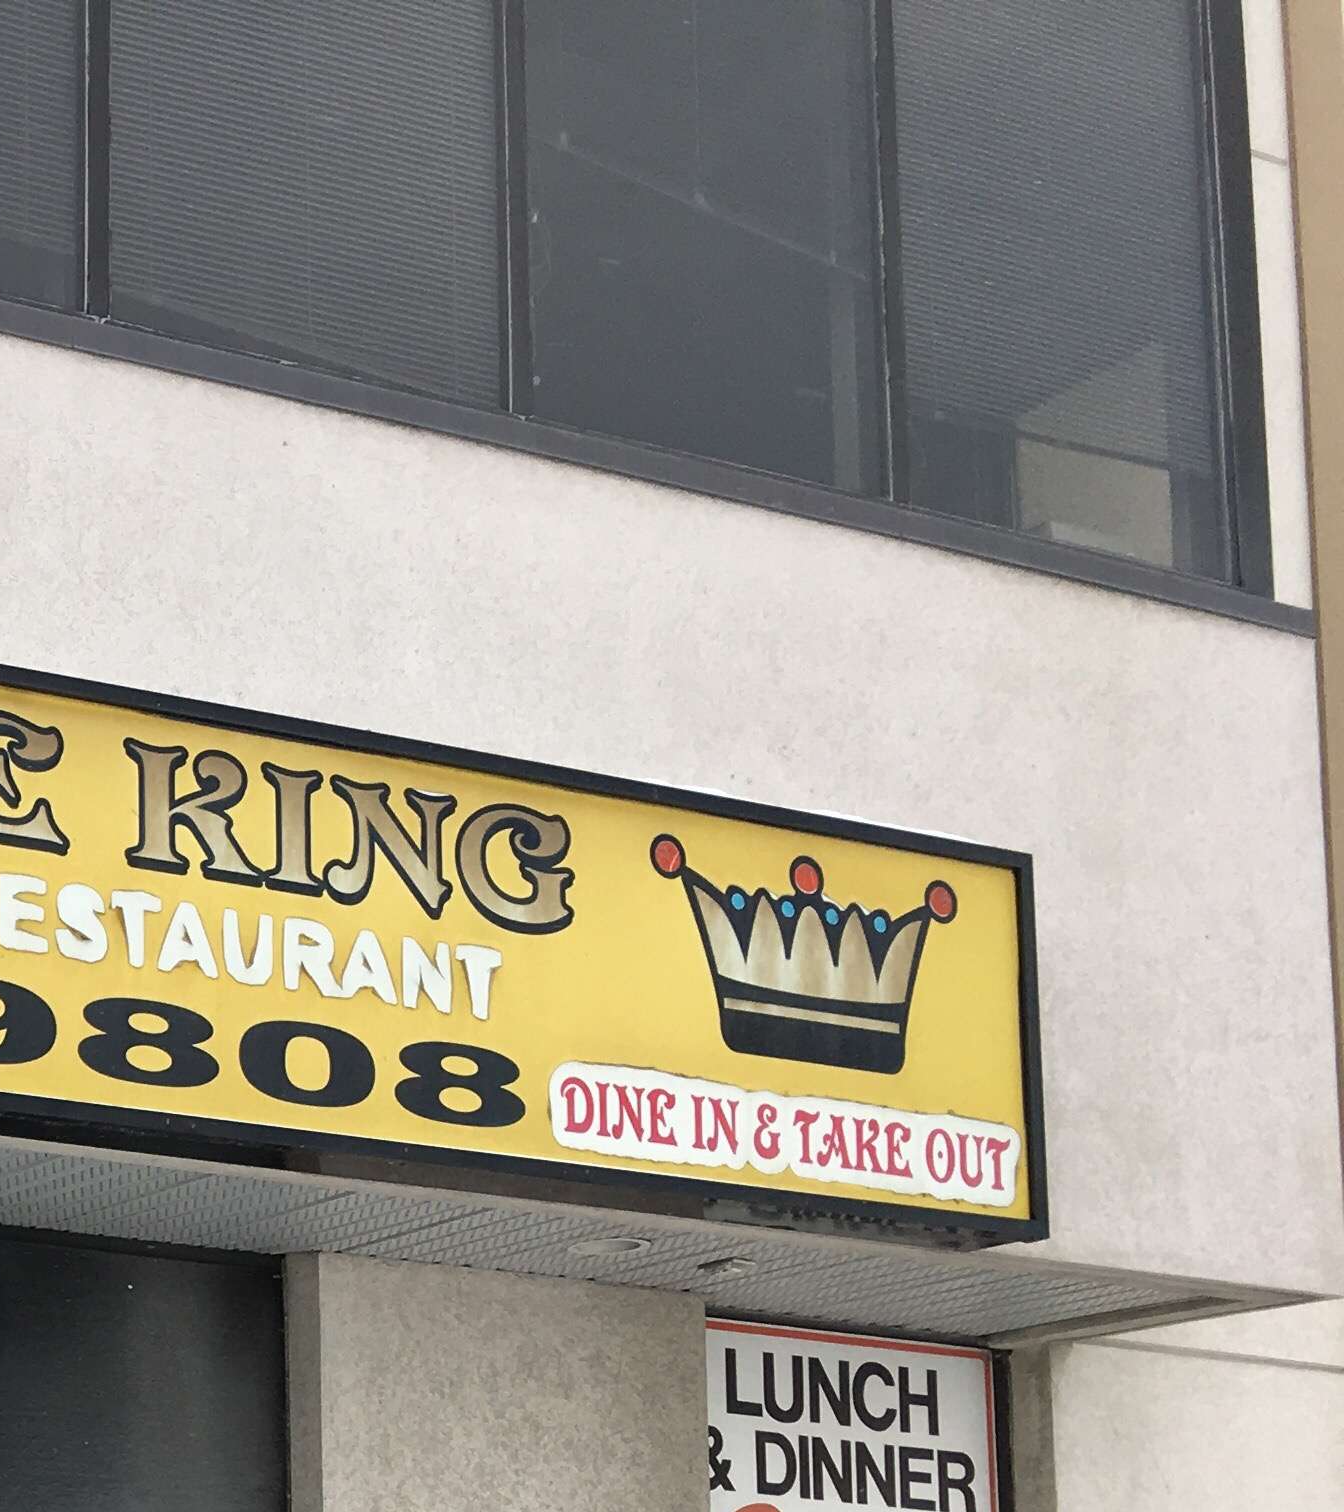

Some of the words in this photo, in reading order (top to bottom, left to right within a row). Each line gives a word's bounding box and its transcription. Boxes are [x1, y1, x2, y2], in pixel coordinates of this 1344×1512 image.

[123, 737, 575, 935] KING
[560, 1076, 678, 1147] DINE
[691, 1095, 740, 1155] IN
[753, 1103, 782, 1160] &
[793, 1110, 913, 1179] TAKE
[925, 1128, 1012, 1191] OUT
[724, 1347, 940, 1436] LUNCH
